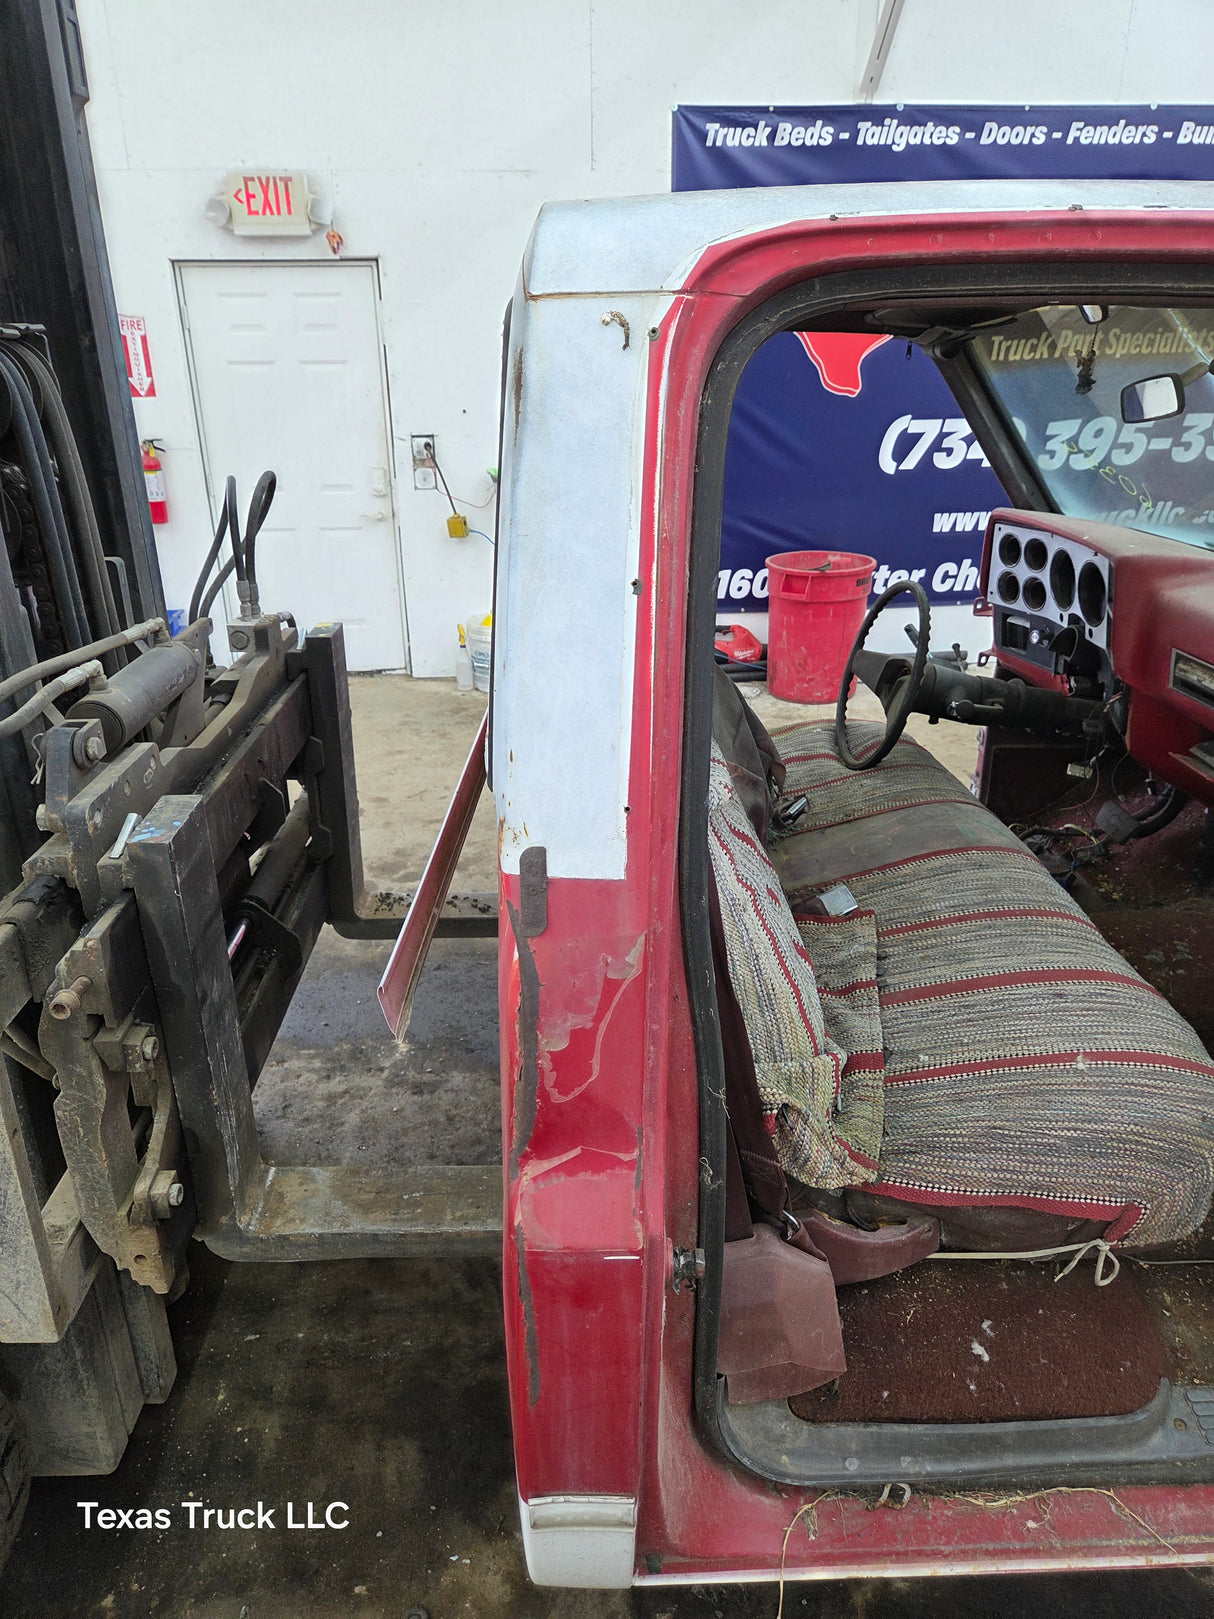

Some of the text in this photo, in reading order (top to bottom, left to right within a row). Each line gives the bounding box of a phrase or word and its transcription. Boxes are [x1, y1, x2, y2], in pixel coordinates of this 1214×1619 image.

[705, 120, 772, 147] Truck
[774, 119, 834, 147] Beds
[856, 118, 961, 152] Tailgates
[980, 121, 1048, 145] Doors
[1066, 119, 1158, 145] Fenders
[243, 175, 293, 216] EXIT
[120, 319, 143, 331] FIRE
[990, 332, 1053, 362] Truck
[1053, 329, 1105, 358] Part
[871, 564, 927, 595] ter
[931, 558, 982, 593] Ch
